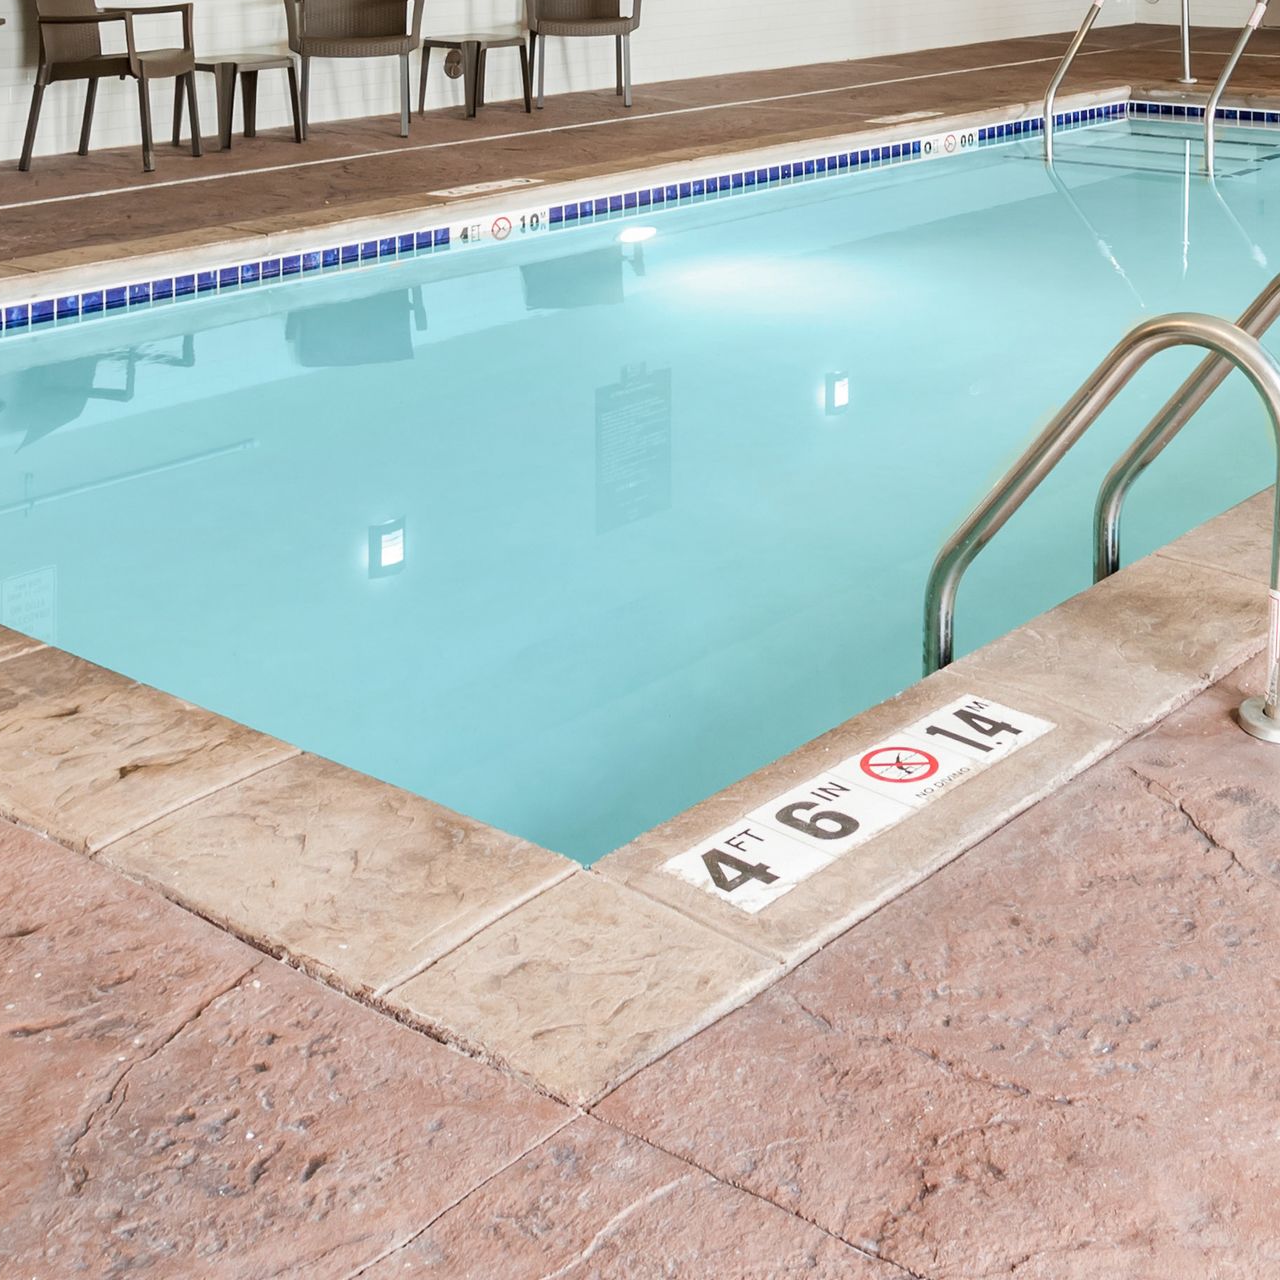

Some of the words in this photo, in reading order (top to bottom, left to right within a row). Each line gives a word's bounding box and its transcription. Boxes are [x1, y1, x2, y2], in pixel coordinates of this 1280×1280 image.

[915, 786, 934, 798] NO
[934, 767, 971, 788] DIVING
[701, 848, 780, 892] 4
[775, 801, 860, 840] 6
